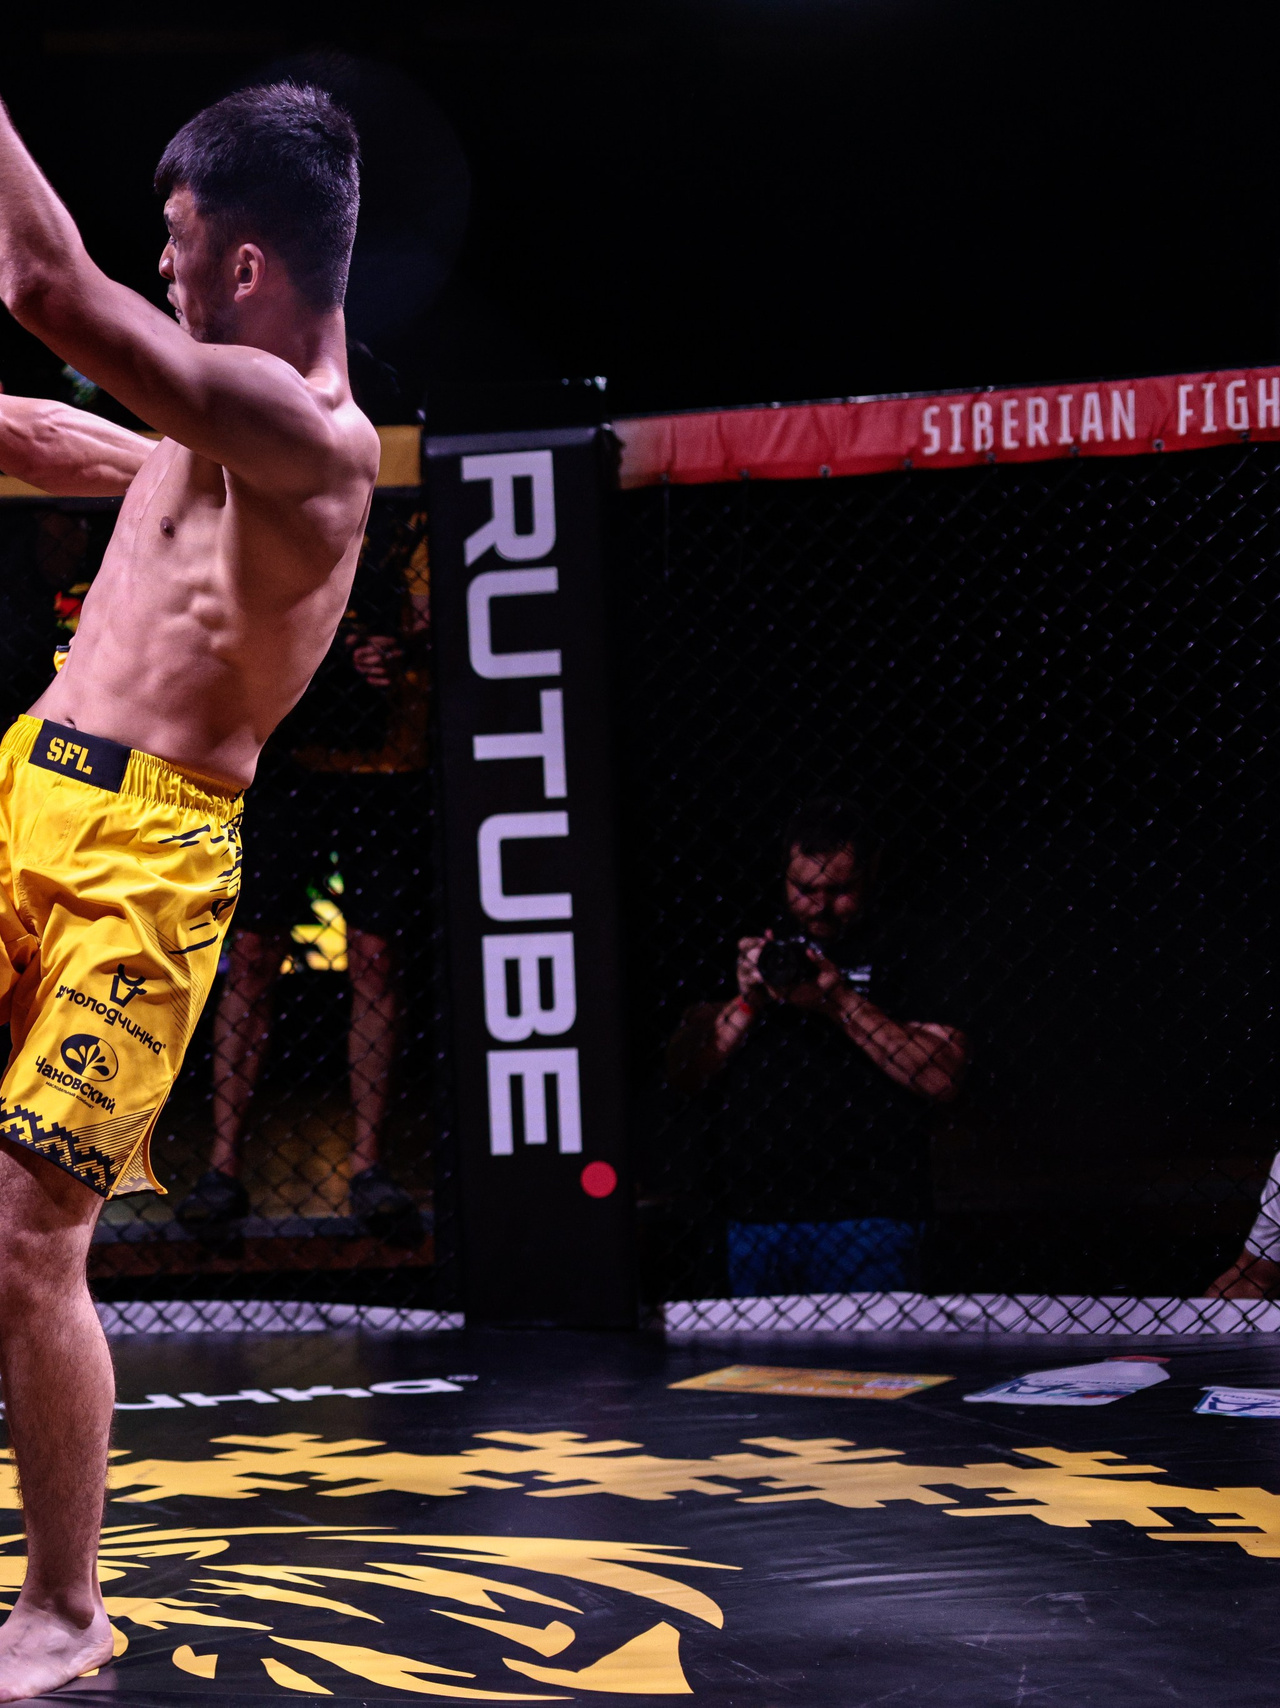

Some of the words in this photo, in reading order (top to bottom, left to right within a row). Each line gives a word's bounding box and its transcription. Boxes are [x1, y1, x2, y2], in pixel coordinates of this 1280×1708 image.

[922, 389, 1136, 456] SIBERIAN
[1177, 377, 1280, 437] FIGH
[46, 736, 93, 776] SFL
[461, 449, 583, 1157] RUTUBE
